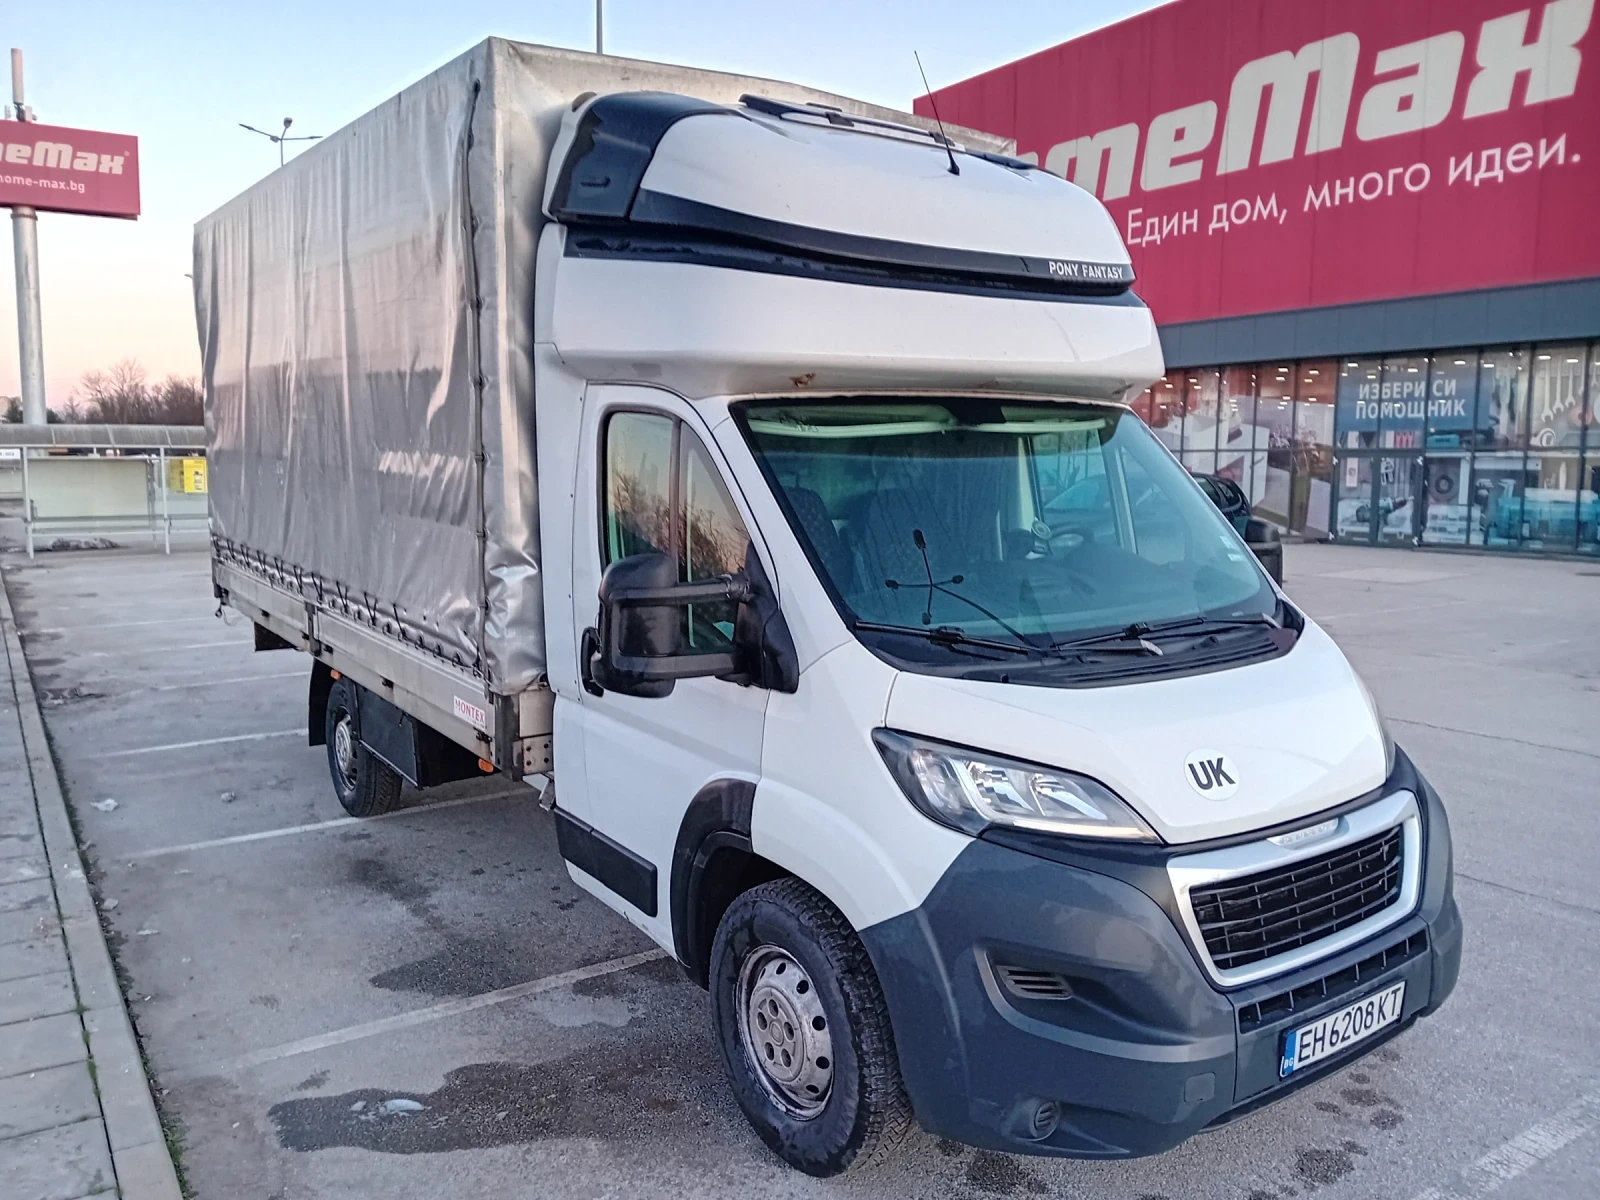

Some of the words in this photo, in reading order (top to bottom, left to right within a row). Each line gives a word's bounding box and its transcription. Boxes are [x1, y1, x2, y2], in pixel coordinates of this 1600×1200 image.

[1016, 0, 1595, 201] meMax
[0, 141, 124, 175] eMax
[1127, 208, 1199, 247] Един
[1208, 192, 1287, 236] дом,
[1303, 162, 1431, 212] много
[1448, 133, 1581, 187] идеи.
[1048, 261, 1078, 277] PONY
[1081, 264, 1123, 280] FANTASY
[1359, 381, 1426, 400] ИЗБЕРИ
[1432, 379, 1457, 397] СИ
[1355, 399, 1466, 421] ПОМОЩНИК
[1188, 757, 1236, 790] UK
[1284, 1057, 1294, 1069] BG
